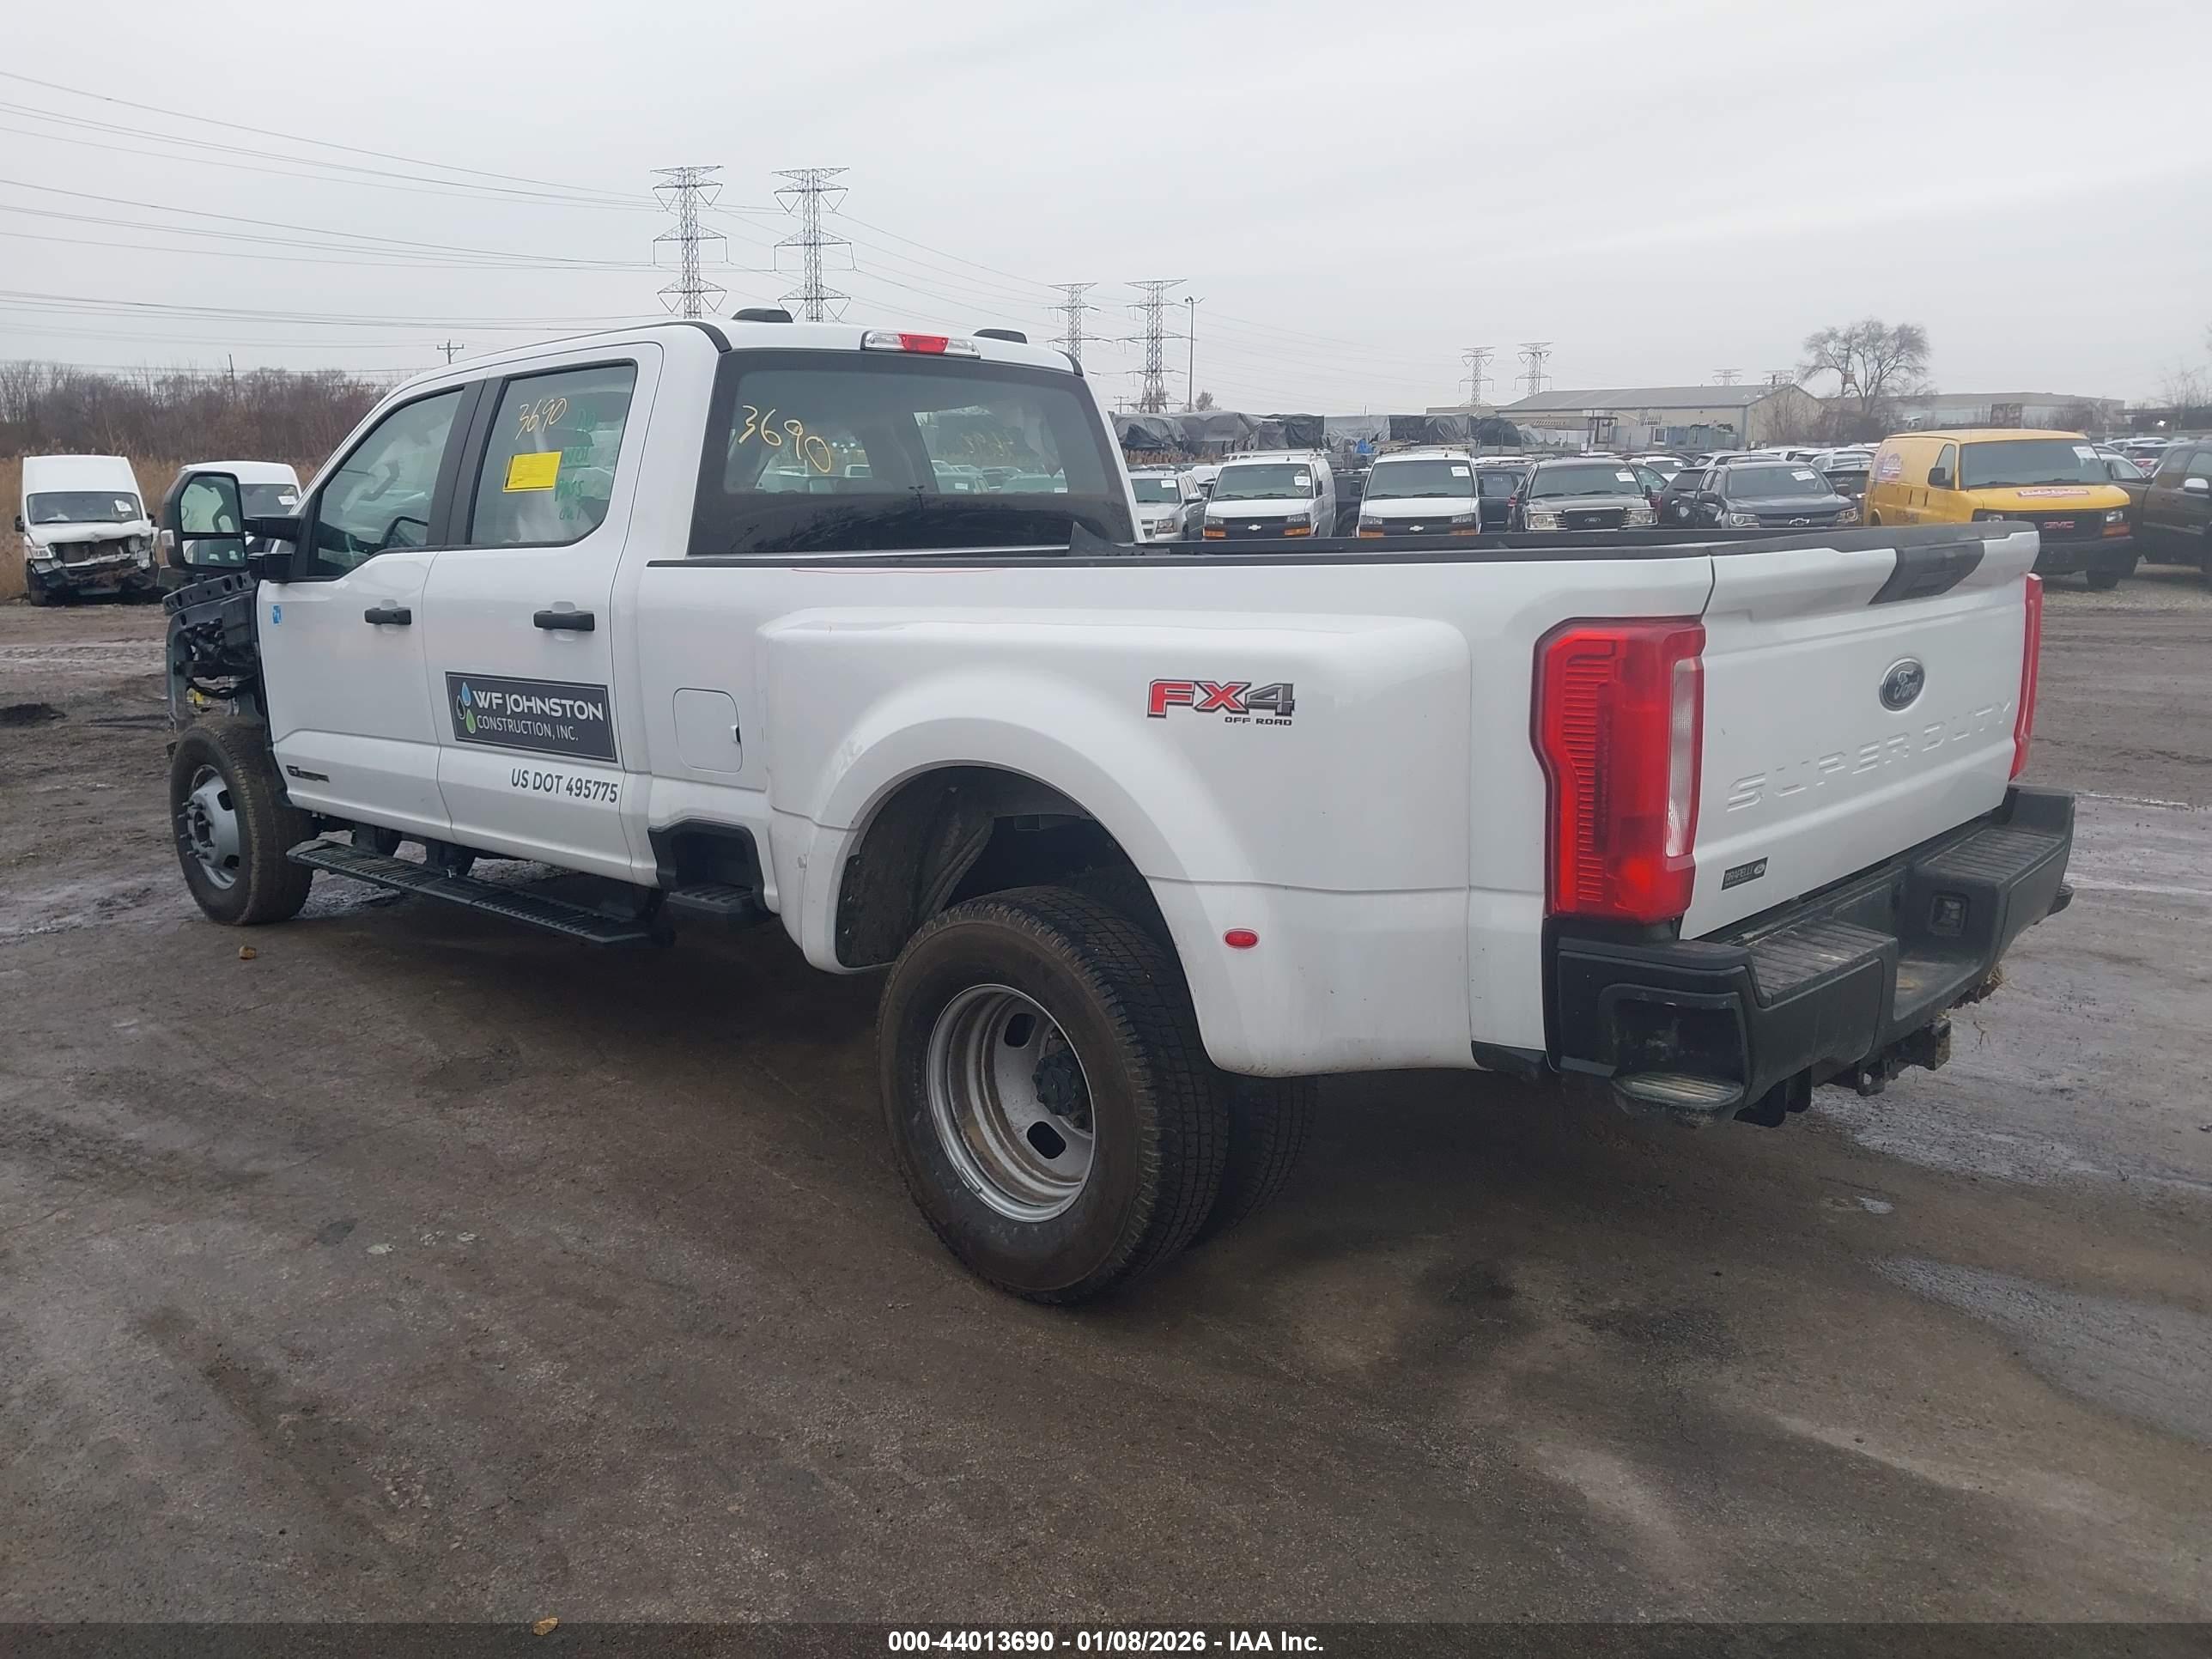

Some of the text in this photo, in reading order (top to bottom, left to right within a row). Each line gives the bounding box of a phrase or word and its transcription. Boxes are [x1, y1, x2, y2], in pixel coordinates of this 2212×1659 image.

[515, 398, 568, 441] 3690
[738, 404, 831, 473] 3690
[473, 690, 605, 721] WF JOHNSTON
[1146, 678, 1296, 719] FX4
[476, 714, 580, 742] CONSTRUCTION, INC.
[1255, 718, 1292, 726] ROAD
[1726, 697, 2012, 813] SUPER DUTY
[511, 768, 619, 804] US DOT 495775
